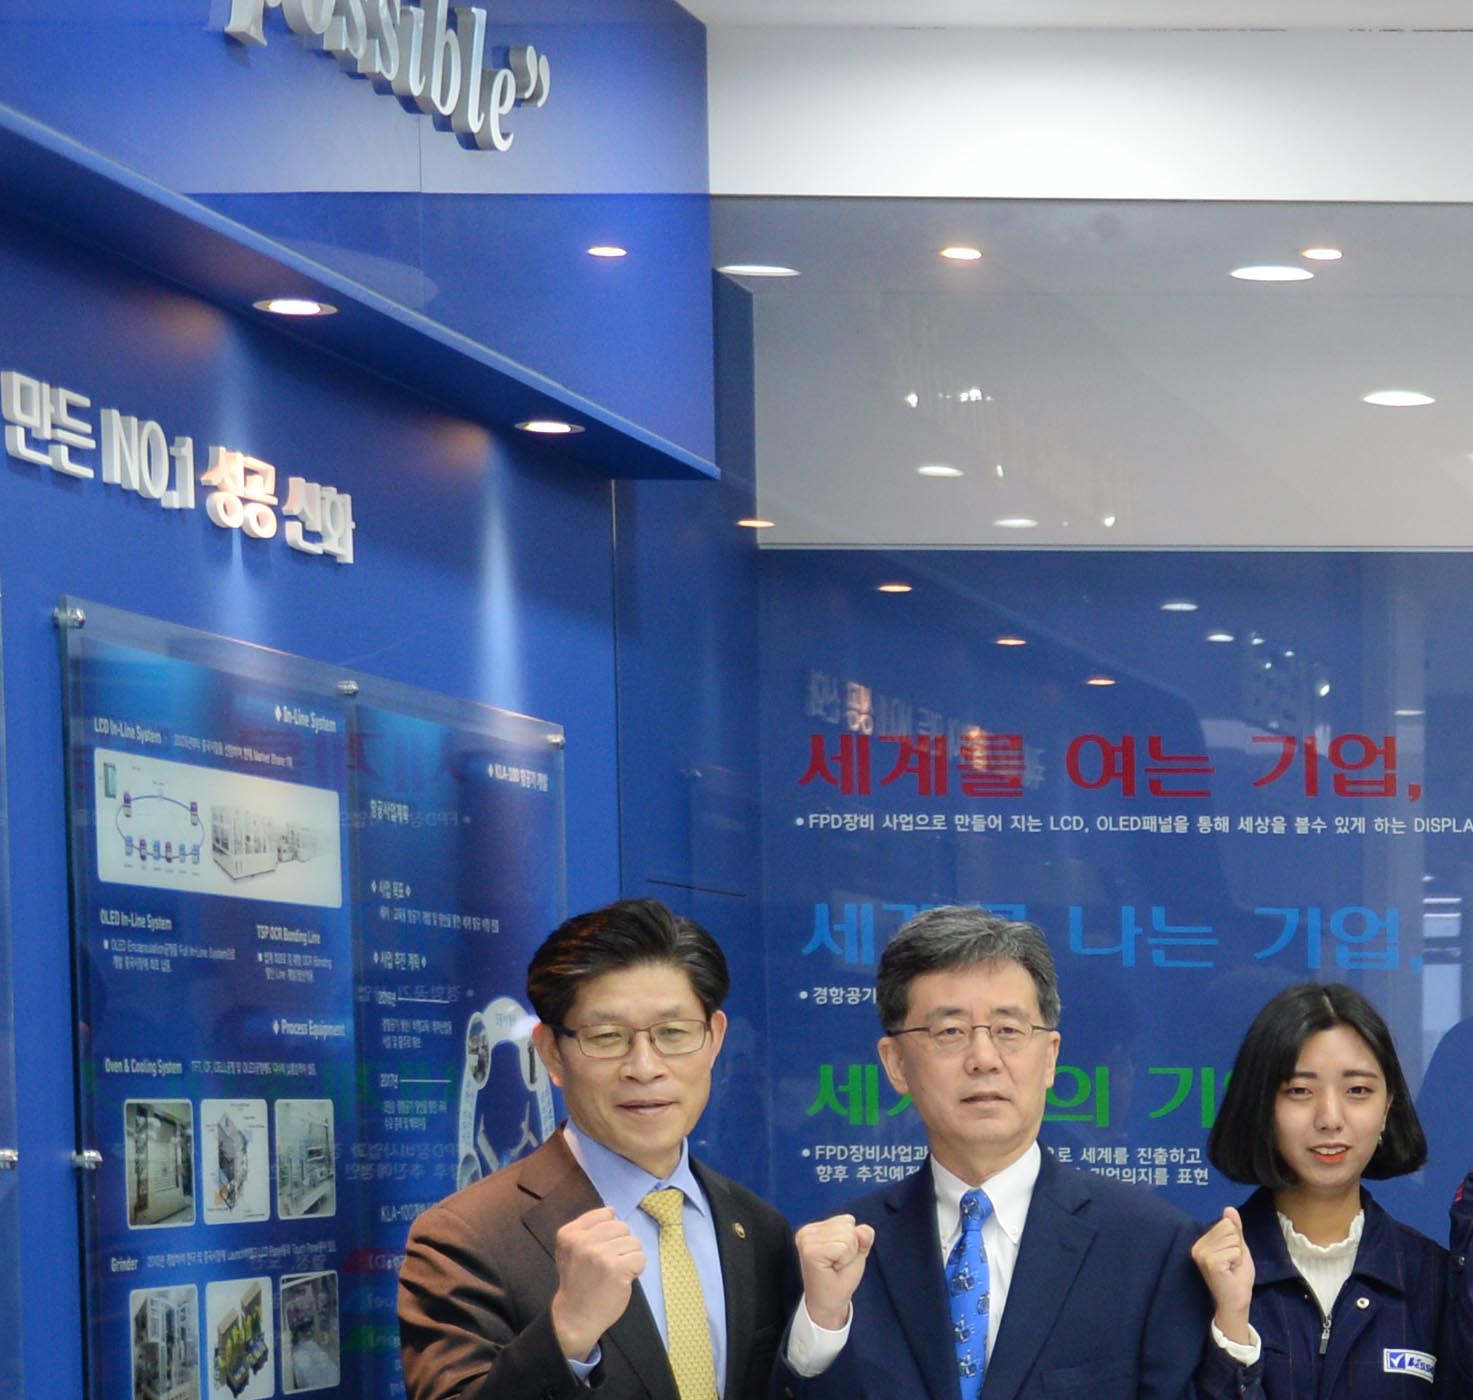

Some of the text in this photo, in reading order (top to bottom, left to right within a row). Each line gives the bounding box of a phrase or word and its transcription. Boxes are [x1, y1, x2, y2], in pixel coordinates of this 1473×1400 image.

[1, 371, 97, 479] 만든
[201, 446, 279, 539] 성공
[798, 733, 1422, 802] 세계를 여는 기업,
[808, 813, 875, 832] FPD장비
[882, 813, 947, 832] 사업으로
[955, 814, 1003, 832] 만들어
[1010, 814, 1043, 832] 지는
[1050, 815, 1090, 834] LCD,
[1096, 815, 1190, 834] OLED패널을
[1197, 815, 1231, 834] 통해
[1237, 815, 1287, 834] 세상을
[1295, 815, 1328, 834] 볼수
[1334, 816, 1366, 834] 있게
[1374, 816, 1407, 834] 하는
[1068, 905, 1220, 968] 나는
[1253, 905, 1425, 976] 기업,
[815, 1165, 849, 1183] 향후
[1176, 1168, 1210, 1186] 표현
[1080, 1147, 1130, 1165] 세계를
[1137, 1147, 1203, 1165] 진출하고
